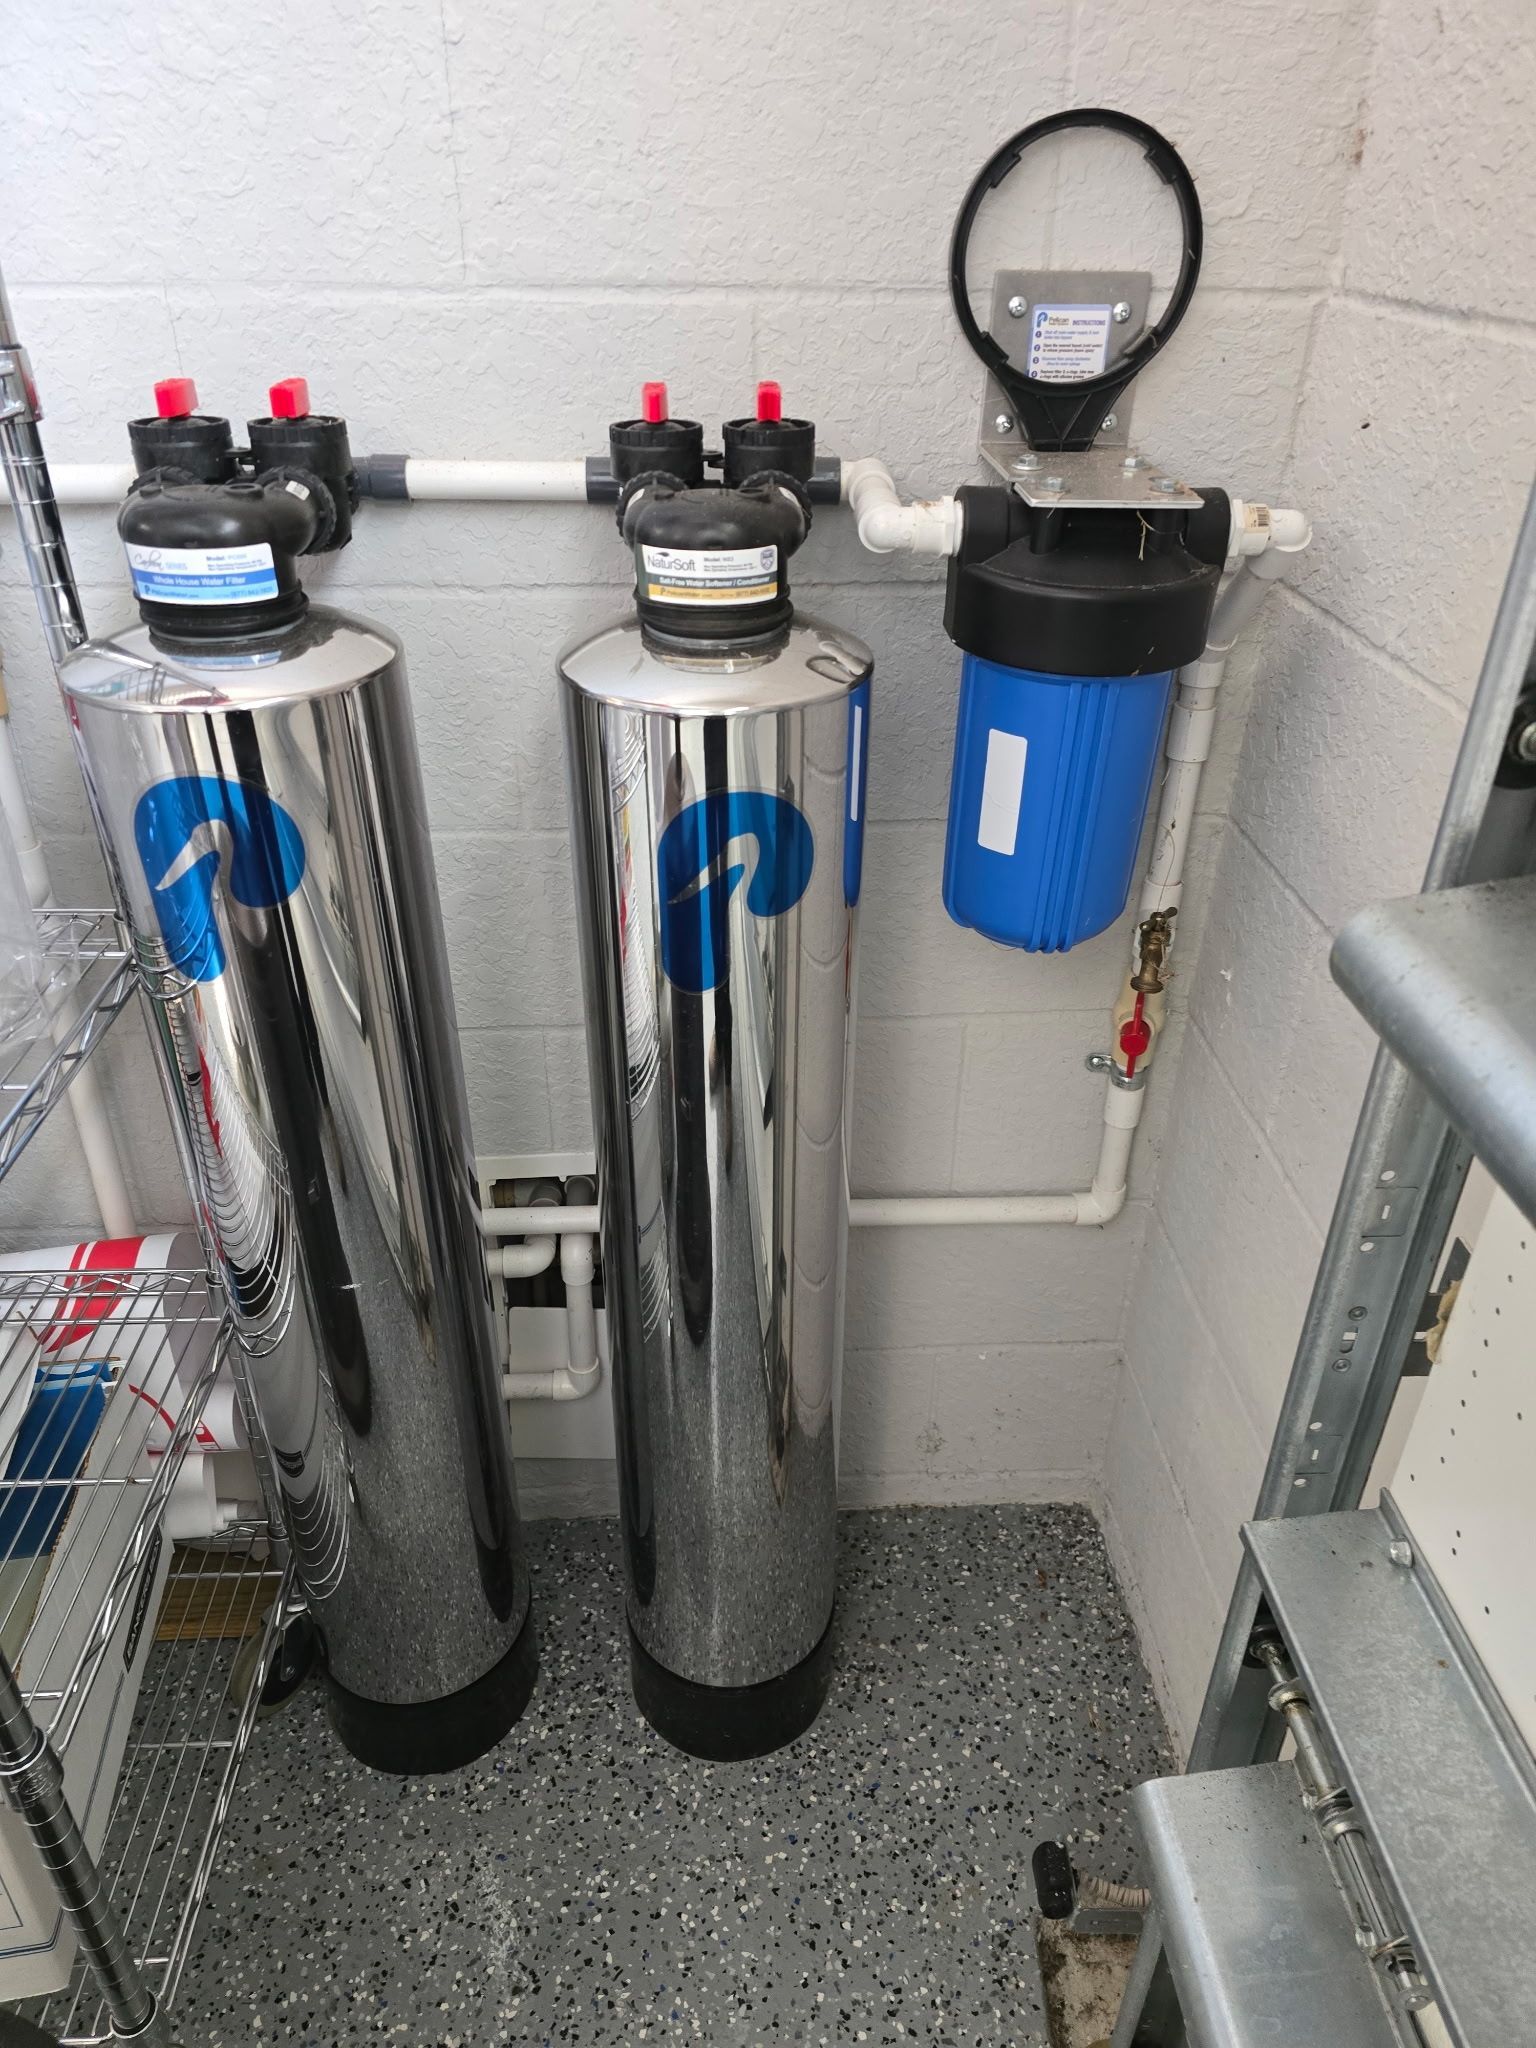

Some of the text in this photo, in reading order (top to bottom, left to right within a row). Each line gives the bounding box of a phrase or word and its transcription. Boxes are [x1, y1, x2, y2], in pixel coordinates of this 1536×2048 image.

[647, 555, 696, 572] NaturSoft
[153, 574, 246, 586] Whole House Water Filter
[659, 576, 686, 587] Salt-Free
[686, 578, 705, 587] Water
[705, 579, 733, 588] Softener
[737, 576, 770, 586] Conditioner
